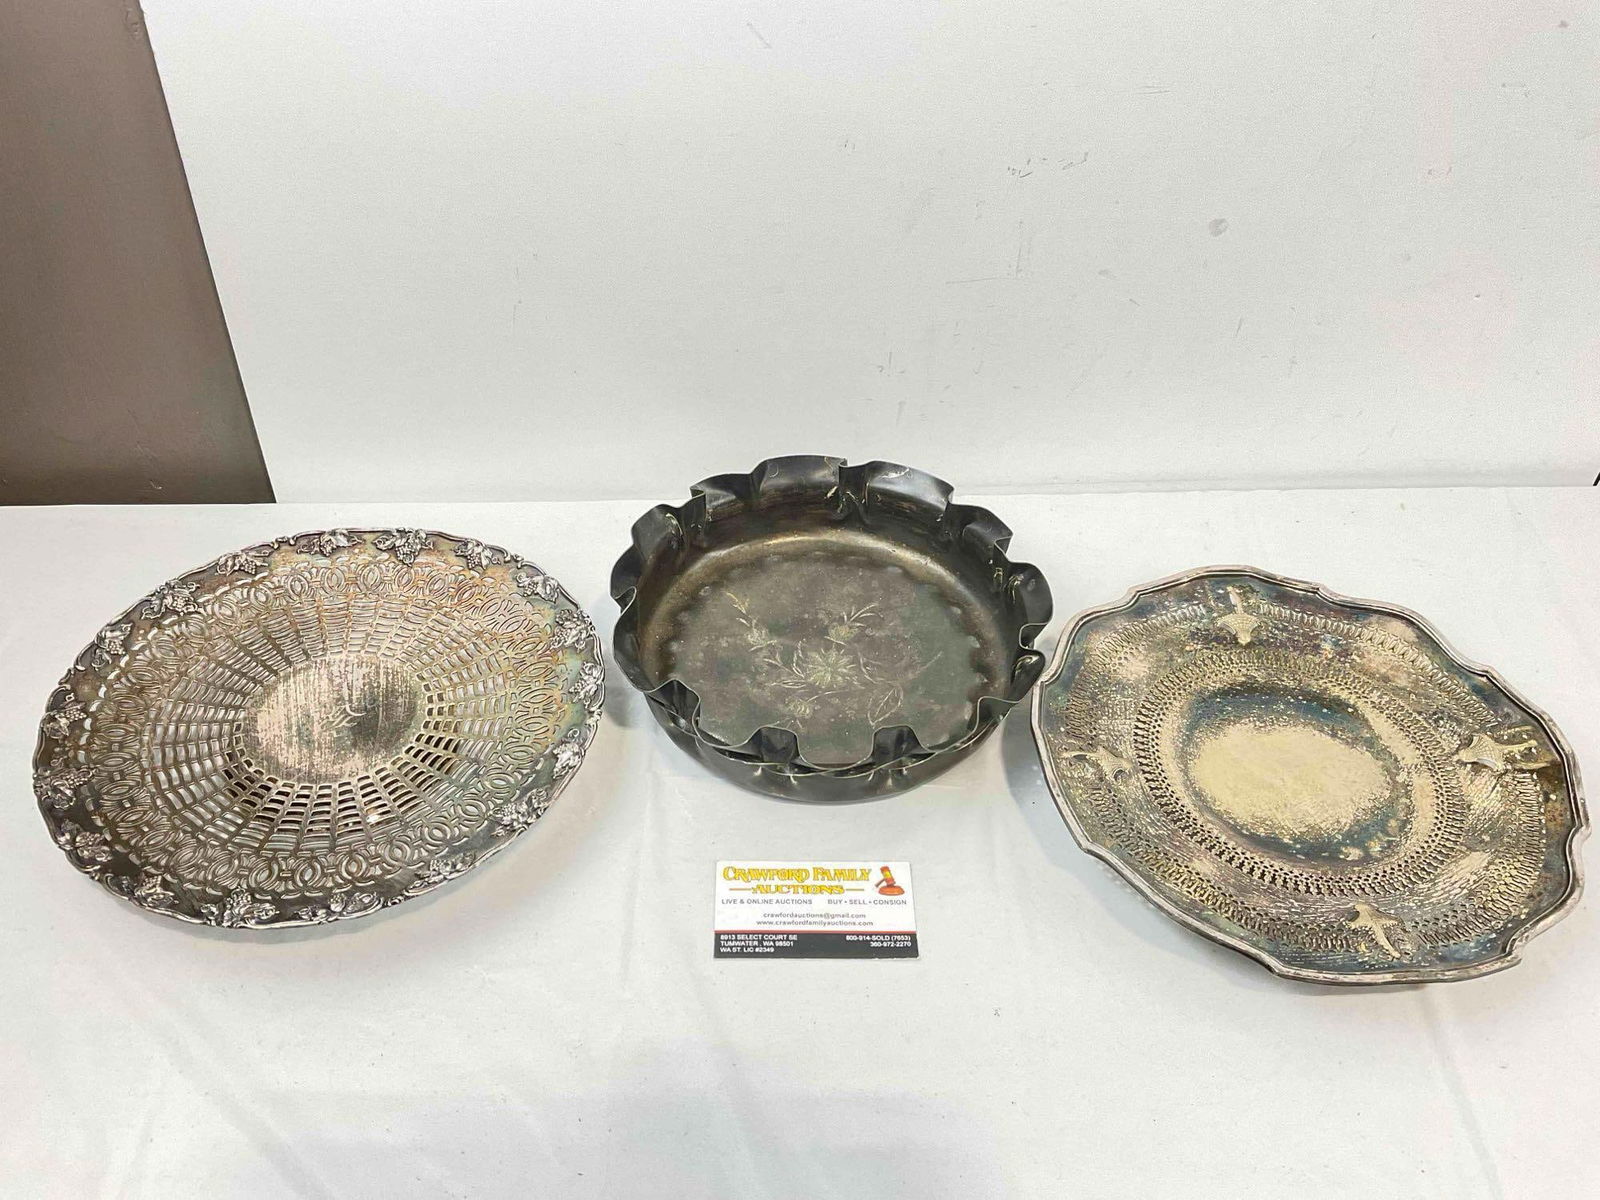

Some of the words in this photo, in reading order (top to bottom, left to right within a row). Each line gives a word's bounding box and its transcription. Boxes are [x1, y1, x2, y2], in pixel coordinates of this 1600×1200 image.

[722, 866, 810, 883] CRAWFORD
[812, 867, 872, 882] FAMILY
[751, 884, 845, 895] AUCTIONS
[763, 911, 866, 919] crawfordauctions@gmail.com
